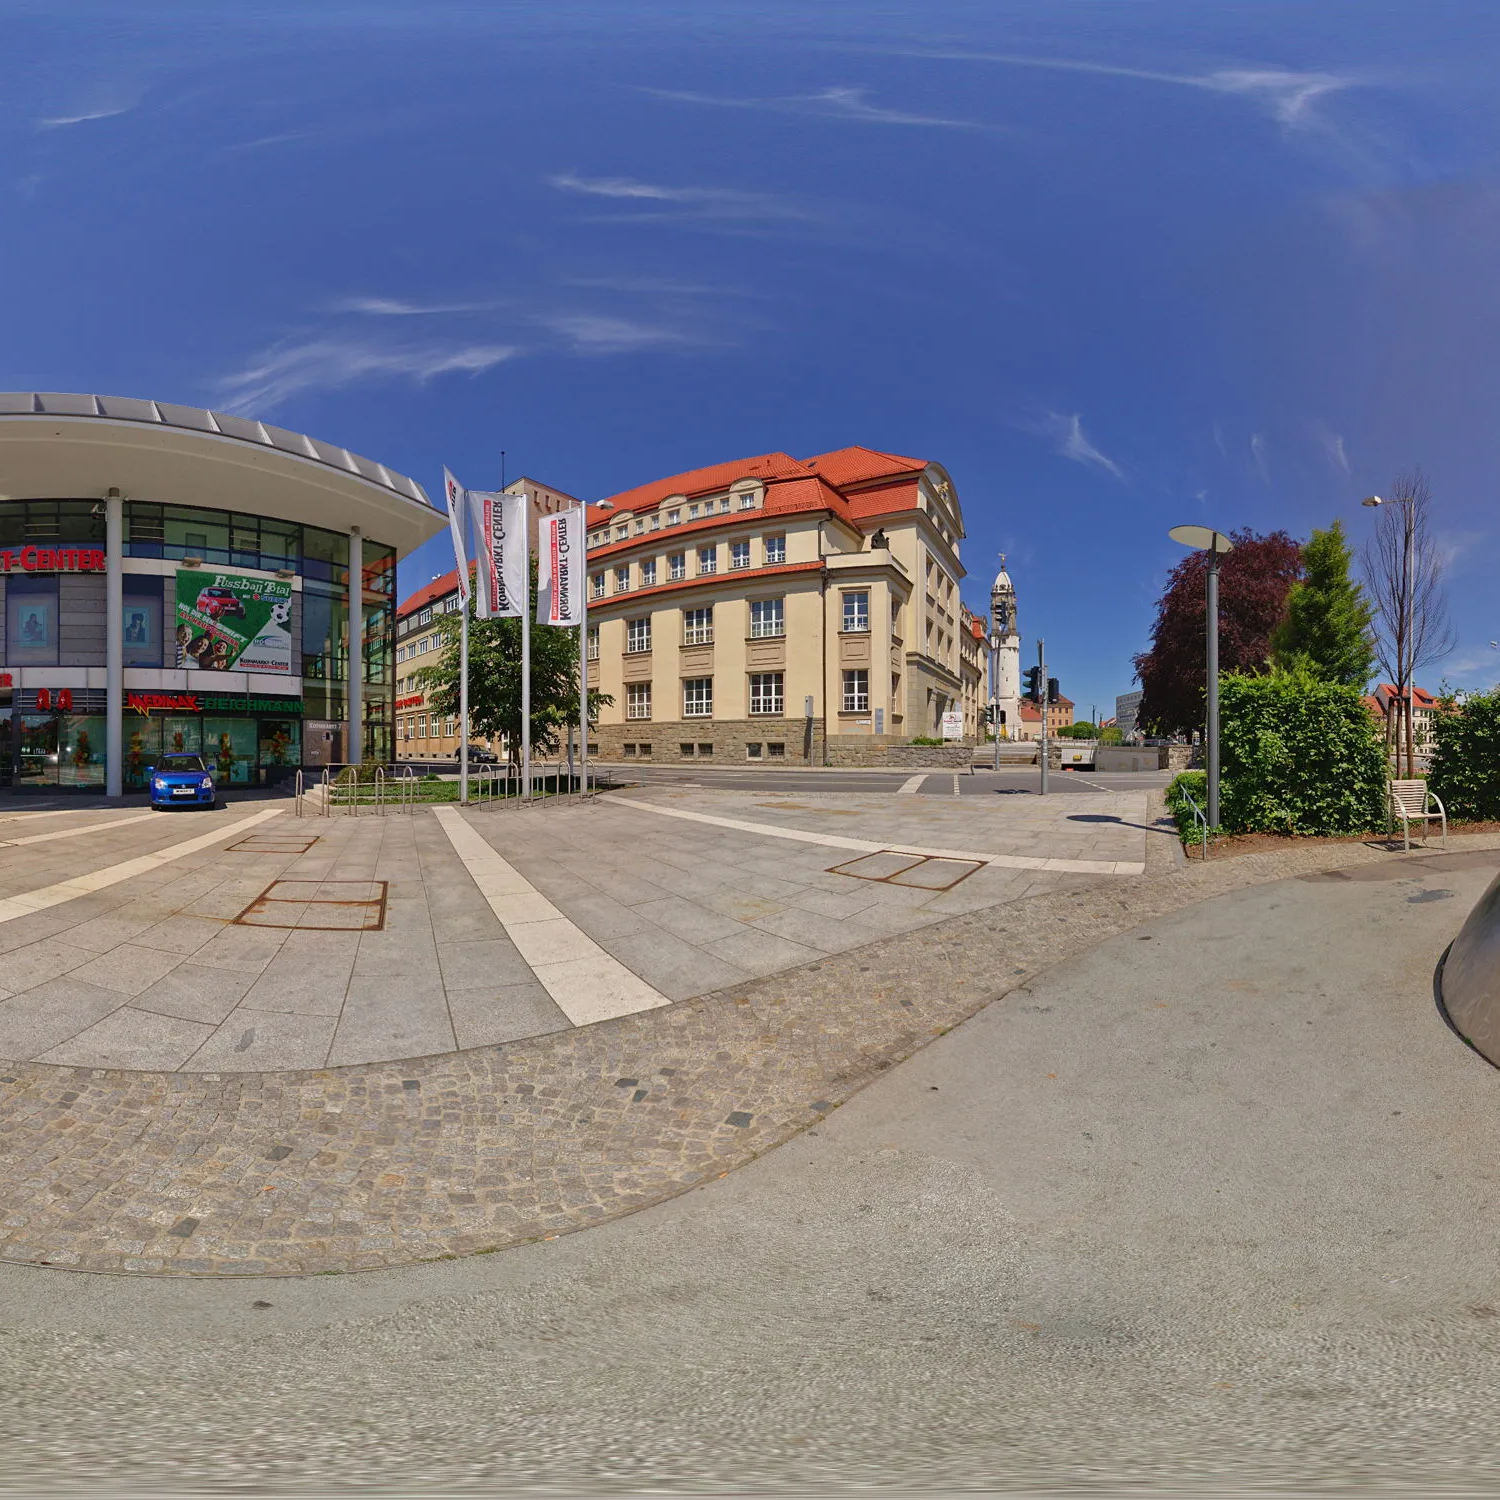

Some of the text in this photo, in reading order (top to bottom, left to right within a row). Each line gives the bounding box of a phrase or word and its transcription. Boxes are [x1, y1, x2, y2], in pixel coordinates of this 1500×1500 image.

[212, 575, 290, 597] Fussball Total
[127, 692, 200, 713] MEDIMAX
[204, 697, 305, 713] DEICHMANN
